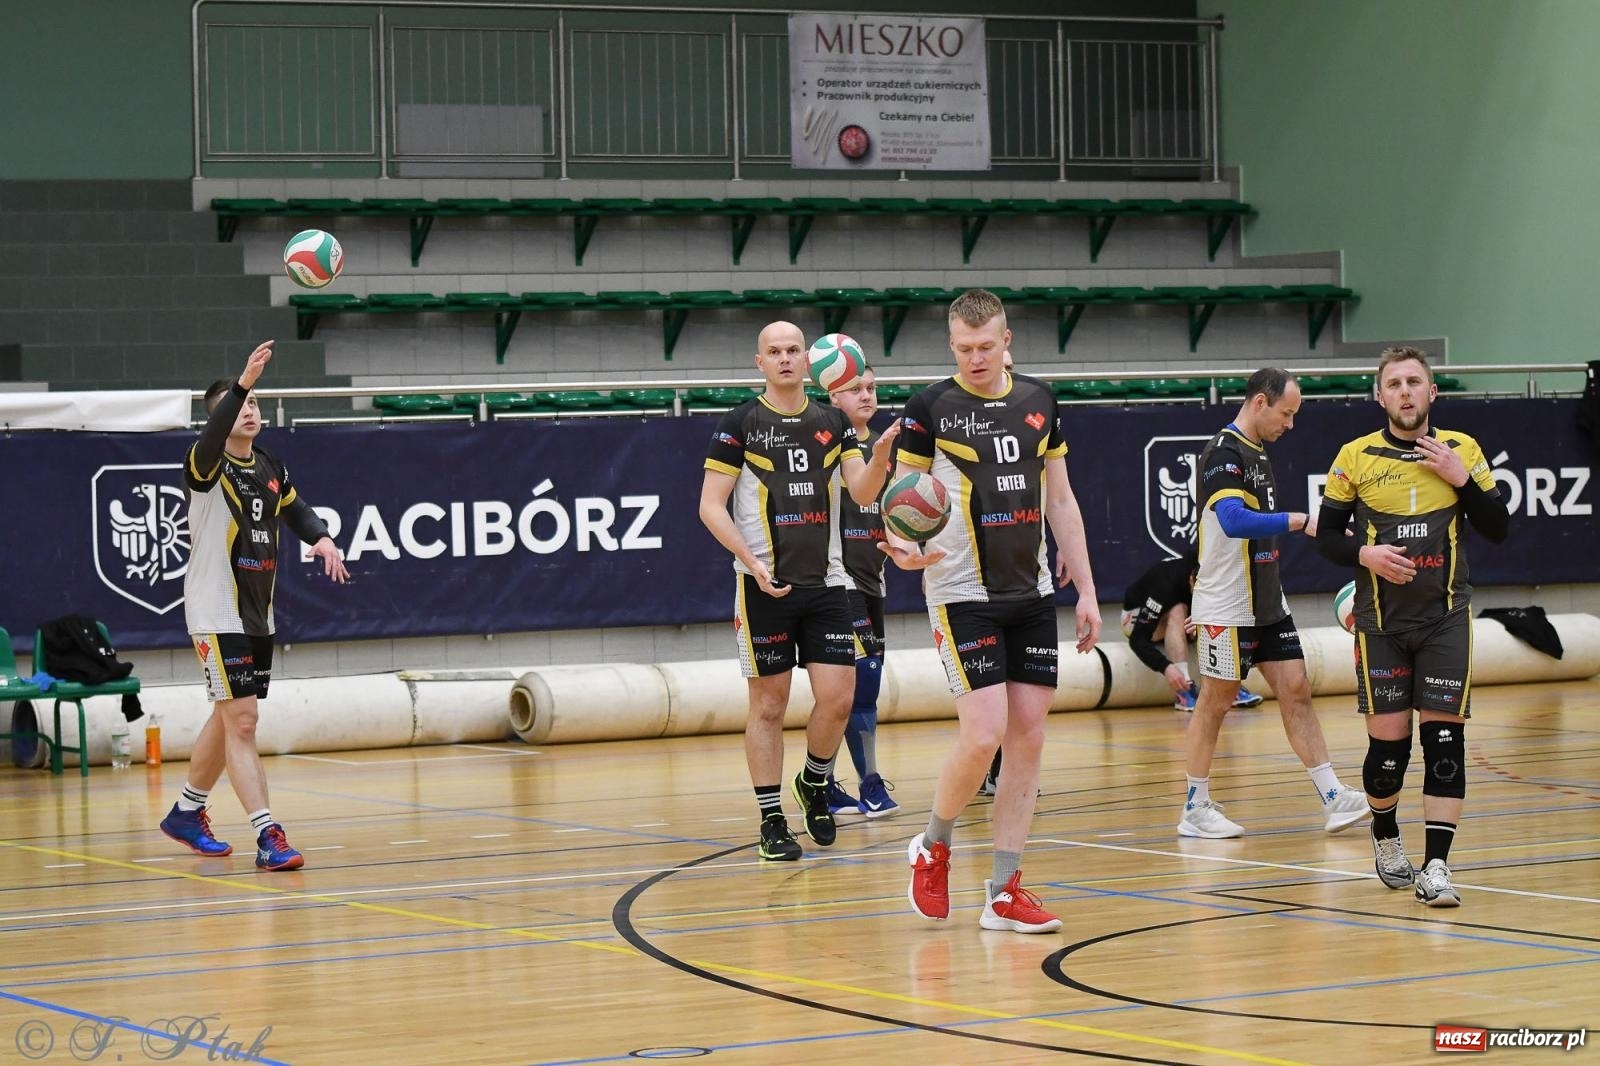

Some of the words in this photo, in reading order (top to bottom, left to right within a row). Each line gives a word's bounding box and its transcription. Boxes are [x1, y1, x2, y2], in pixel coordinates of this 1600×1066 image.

[816, 23, 963, 57] MIESZKO
[817, 78, 862, 89] Operator
[866, 80, 911, 91] urządzeń
[914, 80, 981, 92] cukierniczych
[817, 91, 871, 101] Pracownik
[874, 93, 935, 104] produkcyjny
[879, 112, 921, 122] Czekamy
[941, 113, 974, 122] Ciebie!
[993, 436, 1020, 463] 10
[788, 449, 808, 472] 13
[789, 482, 814, 496] ENTER
[997, 474, 1026, 492] ENTER
[1267, 487, 1275, 510] 5
[251, 498, 263, 521] 9
[1397, 523, 1428, 538] ENTER
[1208, 645, 1217, 667] 5
[1425, 677, 1462, 687] GRAVTON
